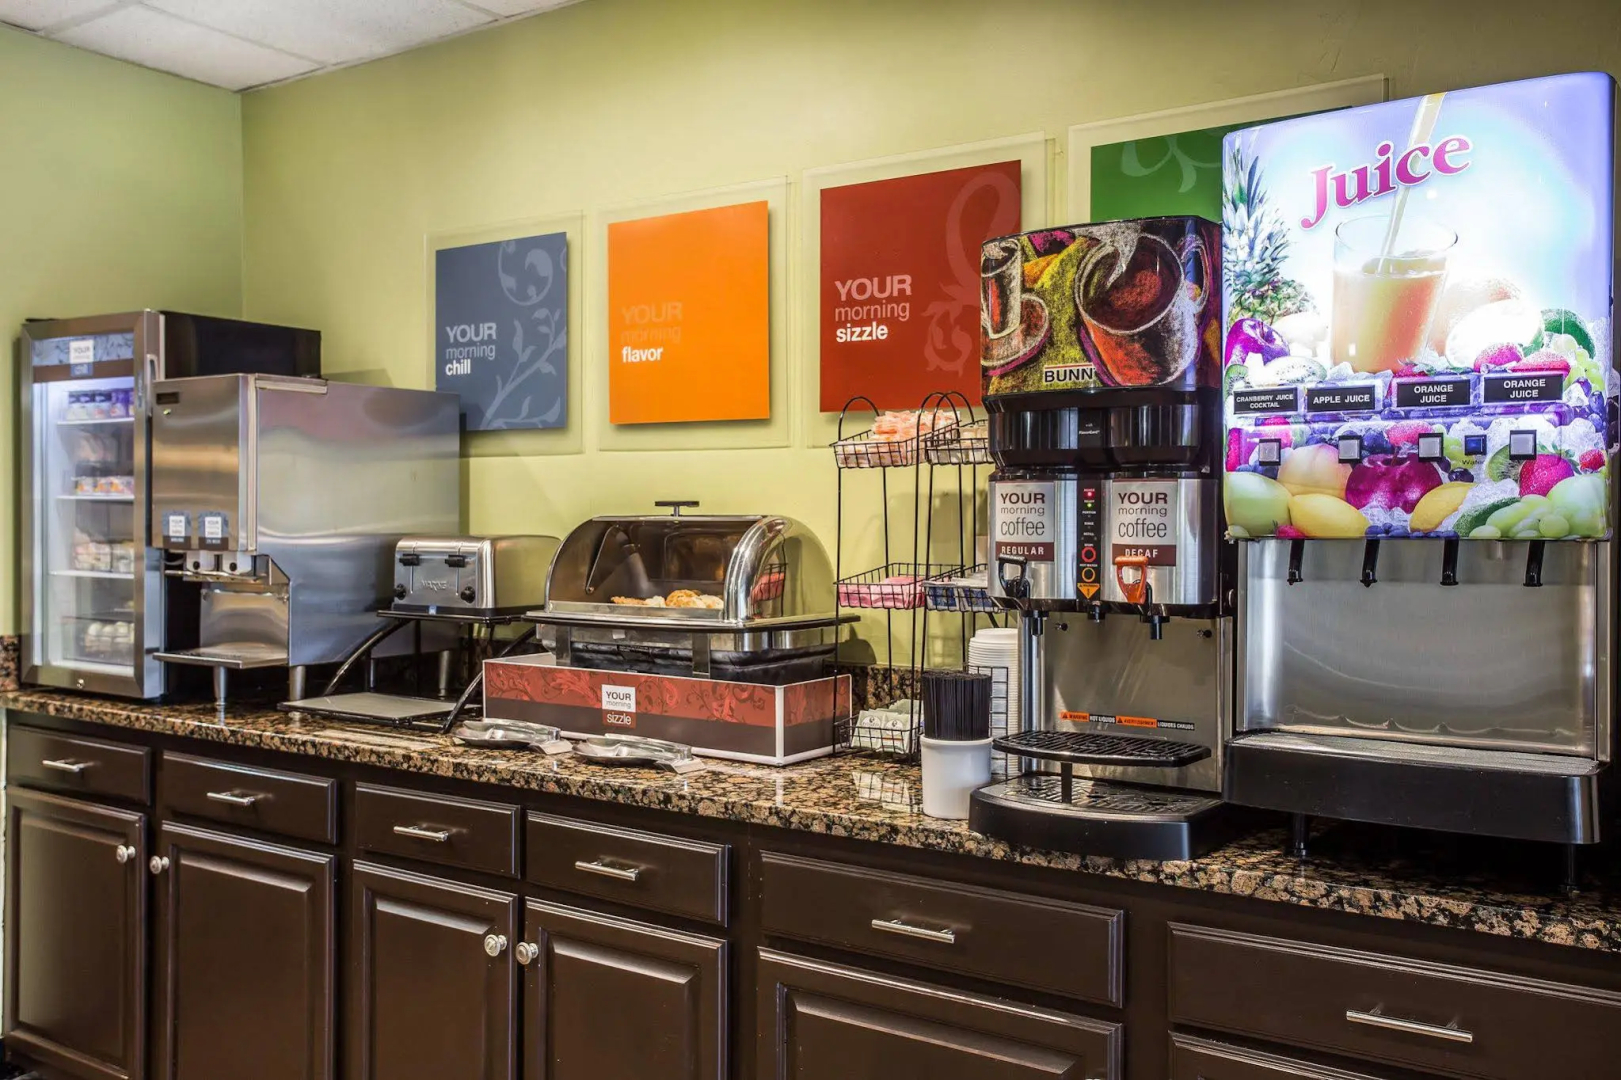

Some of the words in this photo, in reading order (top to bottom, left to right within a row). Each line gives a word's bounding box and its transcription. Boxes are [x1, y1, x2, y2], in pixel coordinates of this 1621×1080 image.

[1300, 136, 1471, 230] Juice
[834, 274, 912, 301] YOUR
[621, 302, 682, 325] YOUR
[835, 299, 910, 321] morning
[445, 322, 497, 343] YOUR
[621, 325, 681, 345] morning
[836, 321, 888, 342] sizzle
[446, 342, 496, 360] morning
[622, 346, 663, 363] flavor
[445, 359, 471, 376] chill
[1044, 367, 1093, 383] BUNN
[1414, 384, 1454, 394] ORANGE
[1503, 378, 1546, 389] ORANGE
[1236, 395, 1273, 403] CRANBERRY
[1313, 395, 1341, 405] APPLE
[1345, 394, 1371, 403] JUICE
[1420, 394, 1447, 404] JUICE
[1510, 389, 1539, 399] JUICE
[1000, 492, 1046, 504] YOUR
[1118, 492, 1168, 504] YOUR
[1000, 505, 1045, 517] morning
[1118, 506, 1168, 518] morning
[1000, 516, 1045, 536] coffee
[1118, 517, 1168, 538] coffee
[1000, 545, 1045, 555] REGULAR
[1124, 548, 1159, 558] DECAF
[605, 690, 632, 701] YOUR
[605, 700, 632, 710] morning
[606, 711, 632, 726] sizzle
